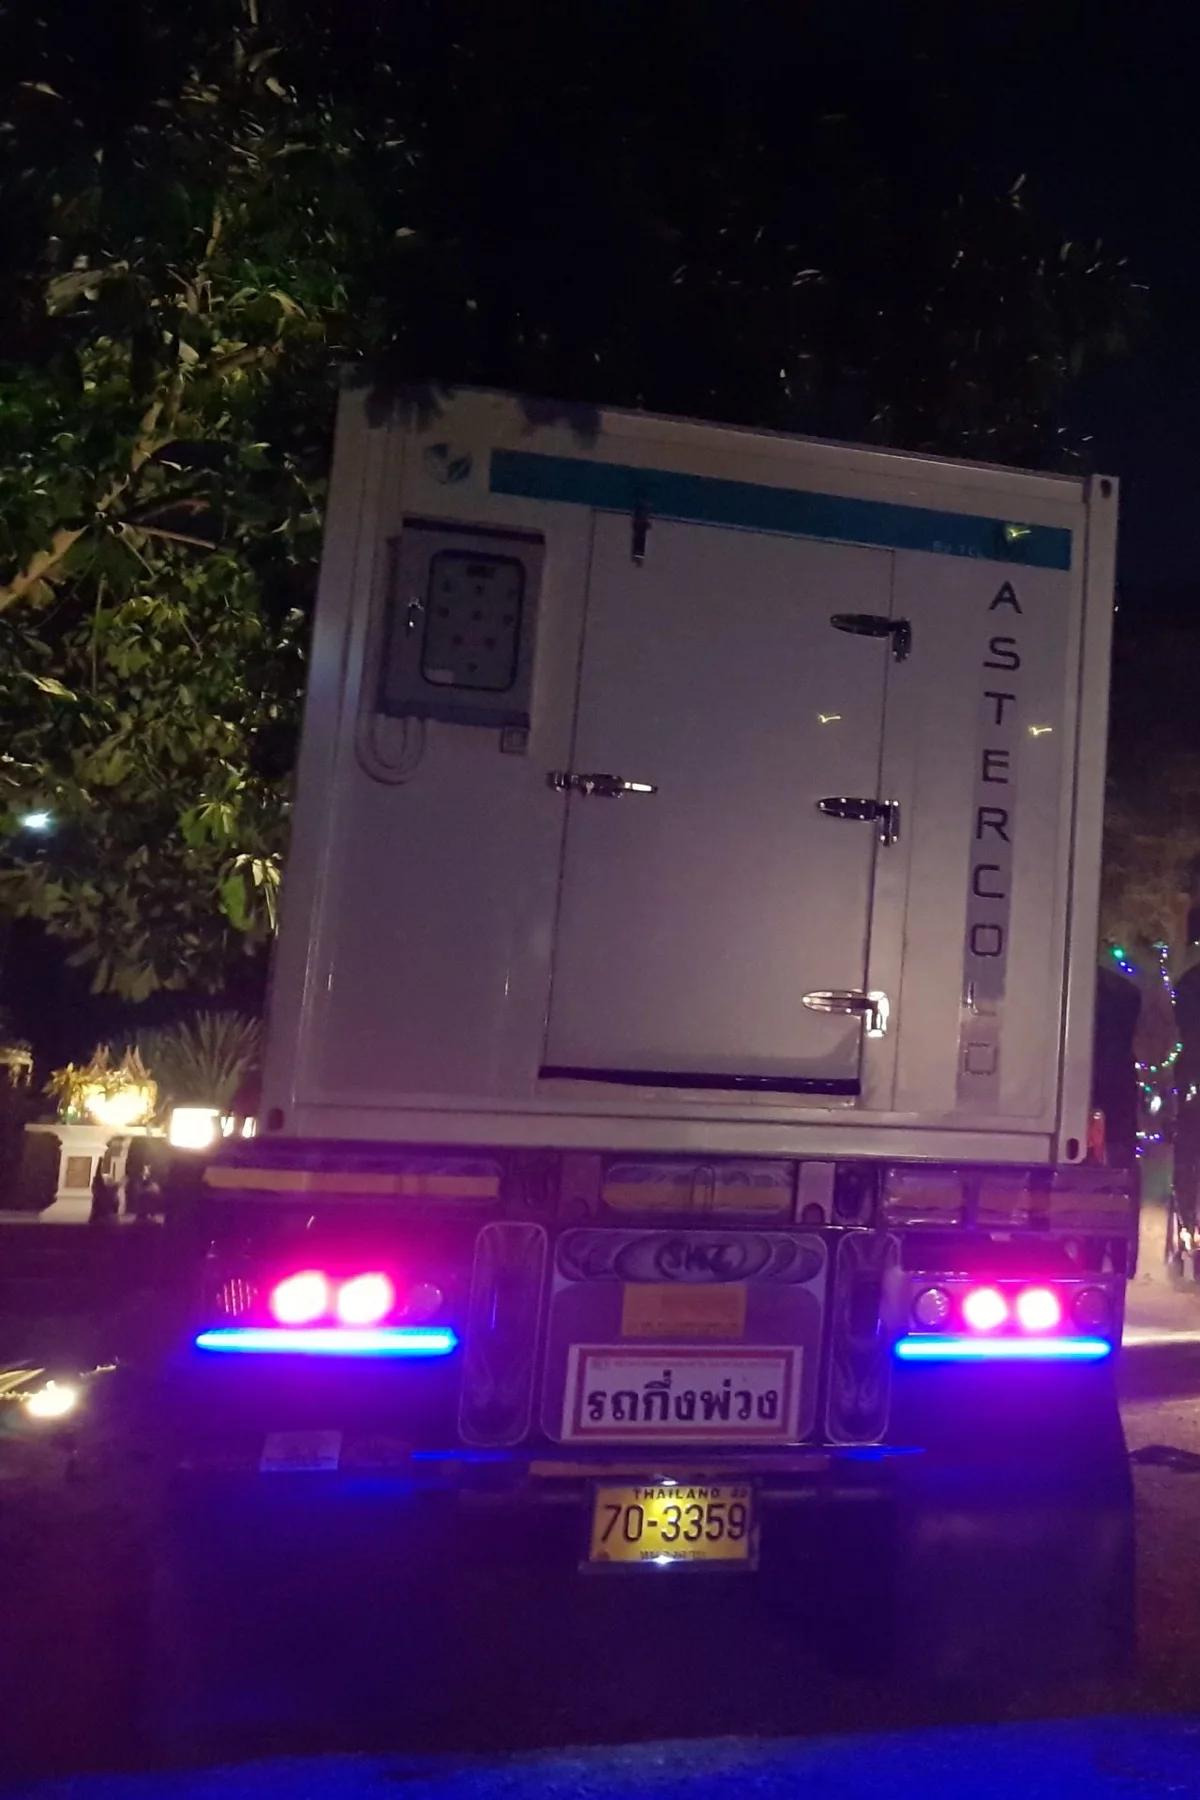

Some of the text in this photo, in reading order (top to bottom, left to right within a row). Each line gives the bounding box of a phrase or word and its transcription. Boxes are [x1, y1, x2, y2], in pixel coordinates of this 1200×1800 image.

[587, 1369, 778, 1421] รถกึ่งพ่วง
[633, 1488, 720, 1500] THAILAND
[601, 1503, 747, 1543] 70-3359
